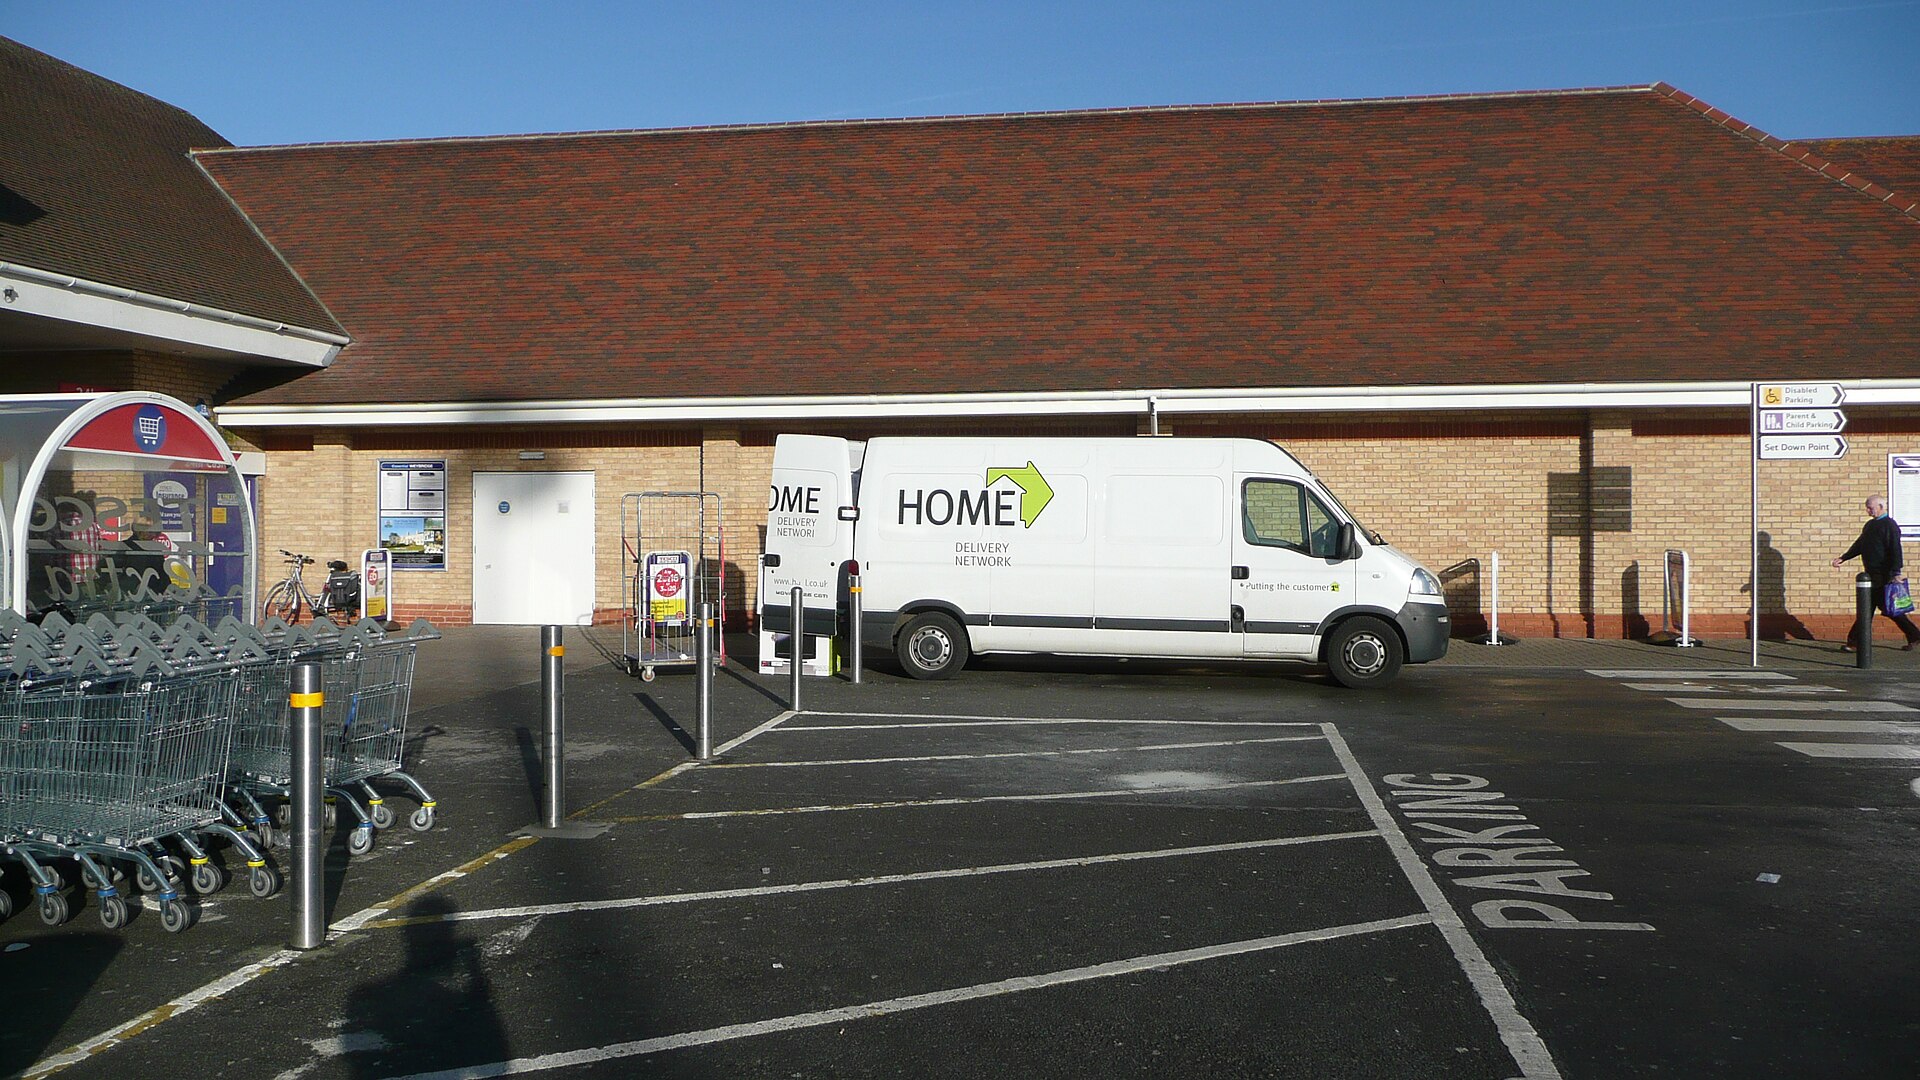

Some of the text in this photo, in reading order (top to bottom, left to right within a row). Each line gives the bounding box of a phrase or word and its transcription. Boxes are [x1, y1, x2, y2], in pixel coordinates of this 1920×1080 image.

[1785, 396, 1813, 404] Parking
[1764, 443, 1830, 451] Set Down Point
[898, 488, 1016, 526] HOME
[777, 516, 817, 527] DELIVERY
[955, 542, 1010, 553] DELIVERY
[955, 555, 1011, 567] NETWORK
[1245, 582, 1274, 591] Putting
[1277, 582, 1290, 590] the
[1292, 583, 1330, 591] customer
[1382, 772, 1656, 931] PARKING
